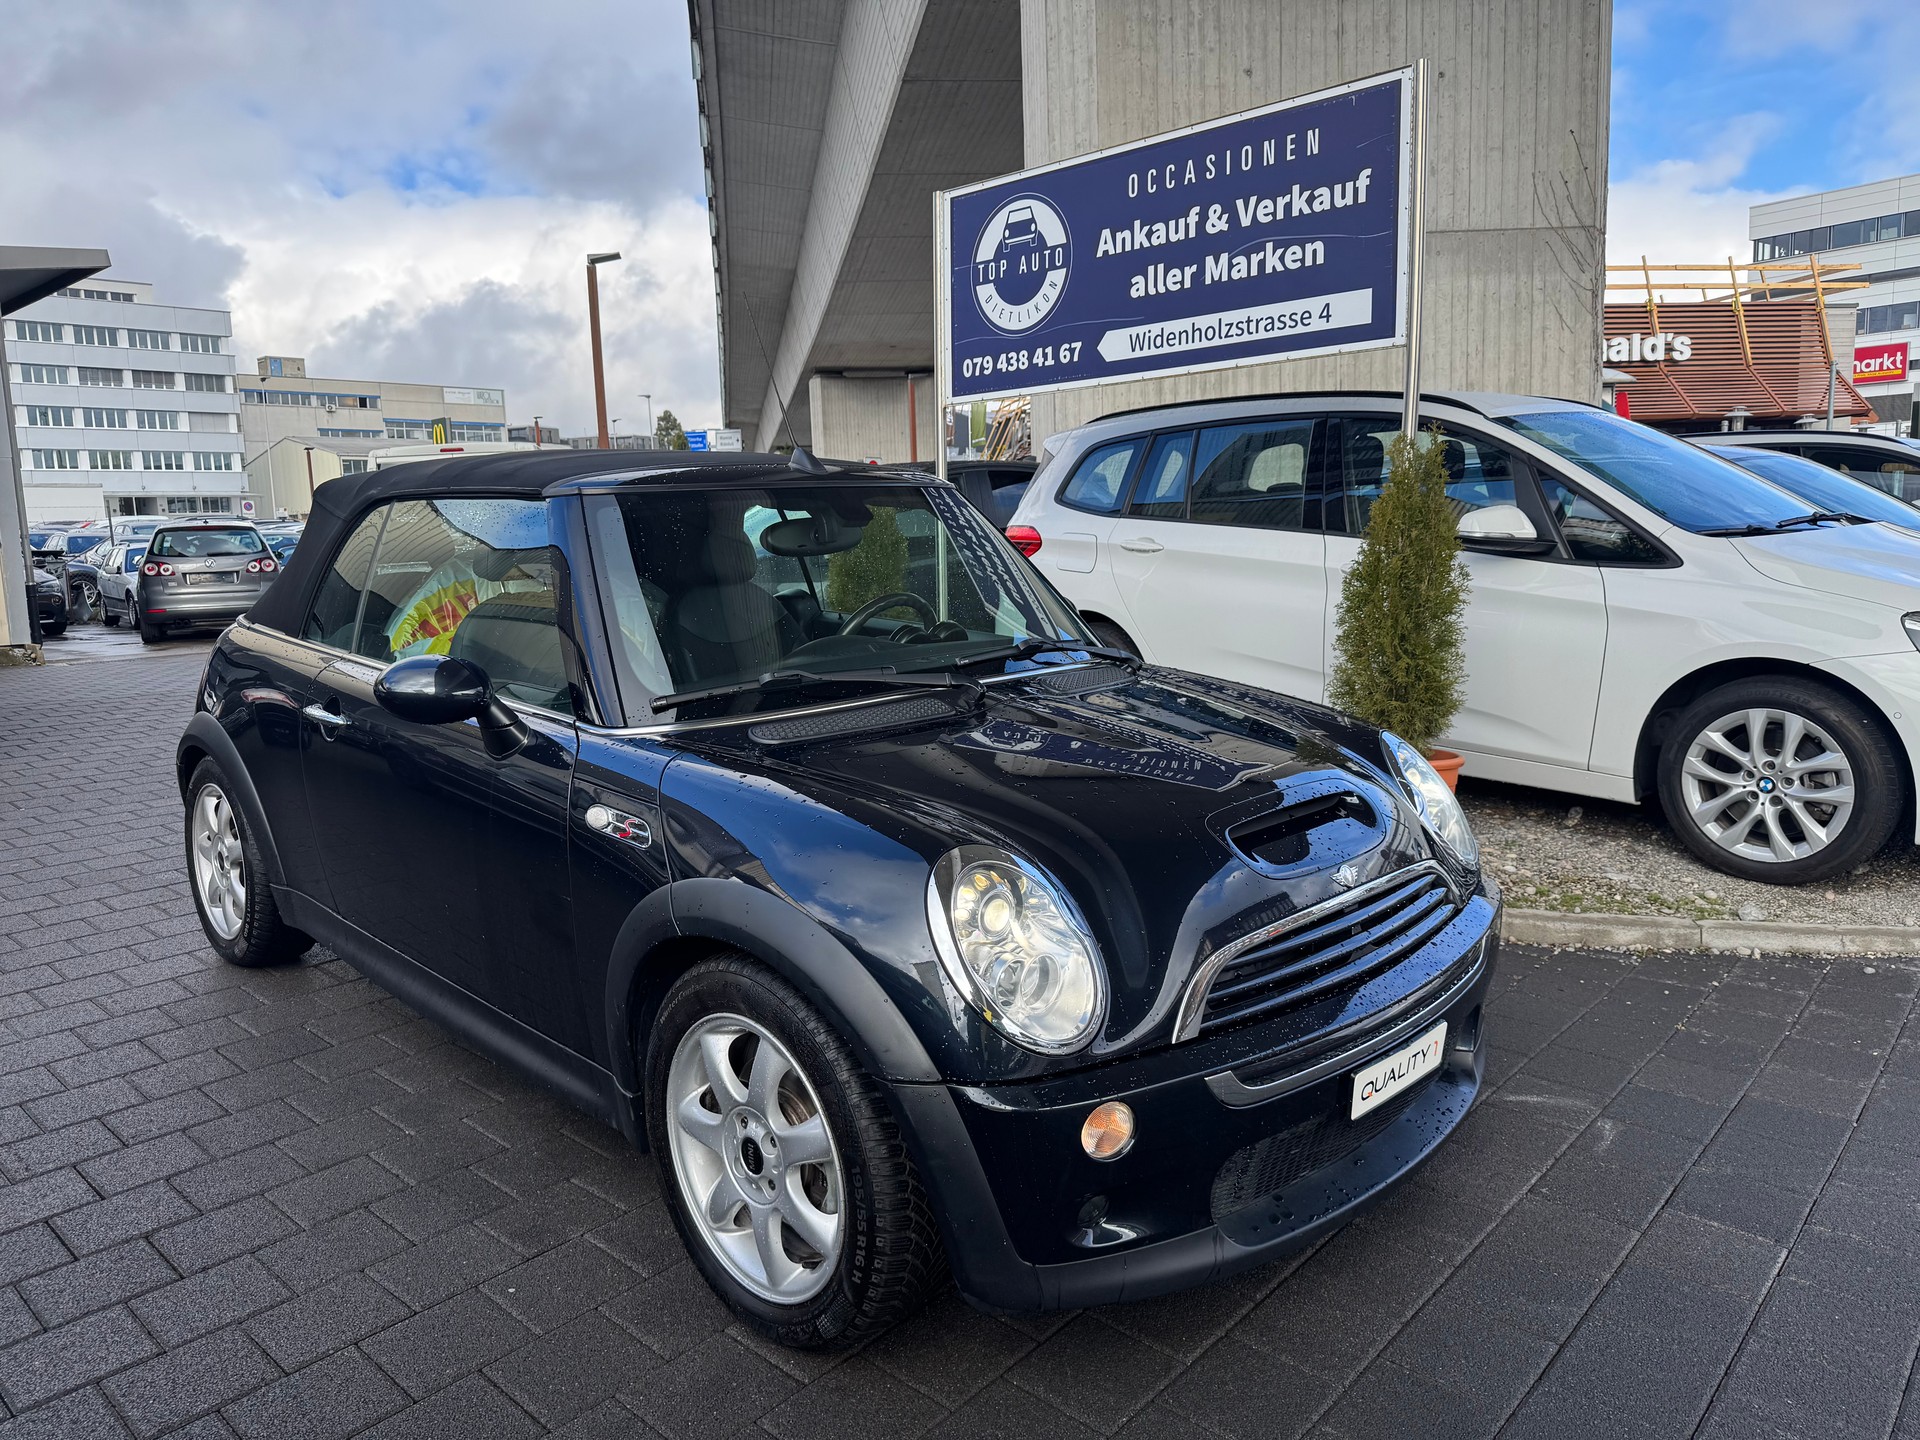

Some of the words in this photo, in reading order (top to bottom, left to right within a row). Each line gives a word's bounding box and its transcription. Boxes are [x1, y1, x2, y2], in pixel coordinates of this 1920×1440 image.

[1128, 128, 1320, 198] OCCASIONEN
[1096, 206, 1200, 258] Ankauf
[1205, 203, 1229, 235] &
[1235, 168, 1372, 228] Verkauf
[978, 259, 1007, 283] TOP
[1019, 247, 1063, 275] AUTO
[1130, 263, 1198, 299] aller
[1204, 240, 1325, 285] Marken
[985, 280, 1058, 323] DIETLIKON
[1129, 309, 1313, 353] Widenholzstrasse
[1318, 302, 1332, 324] 4
[963, 355, 993, 378] 079
[996, 350, 1029, 373] 438
[1032, 346, 1055, 368] 41
[1059, 341, 1082, 364] 67
[1360, 1044, 1431, 1102] QUALITY
[1433, 1040, 1439, 1057] 1
[747, 1142, 756, 1171] MINI
